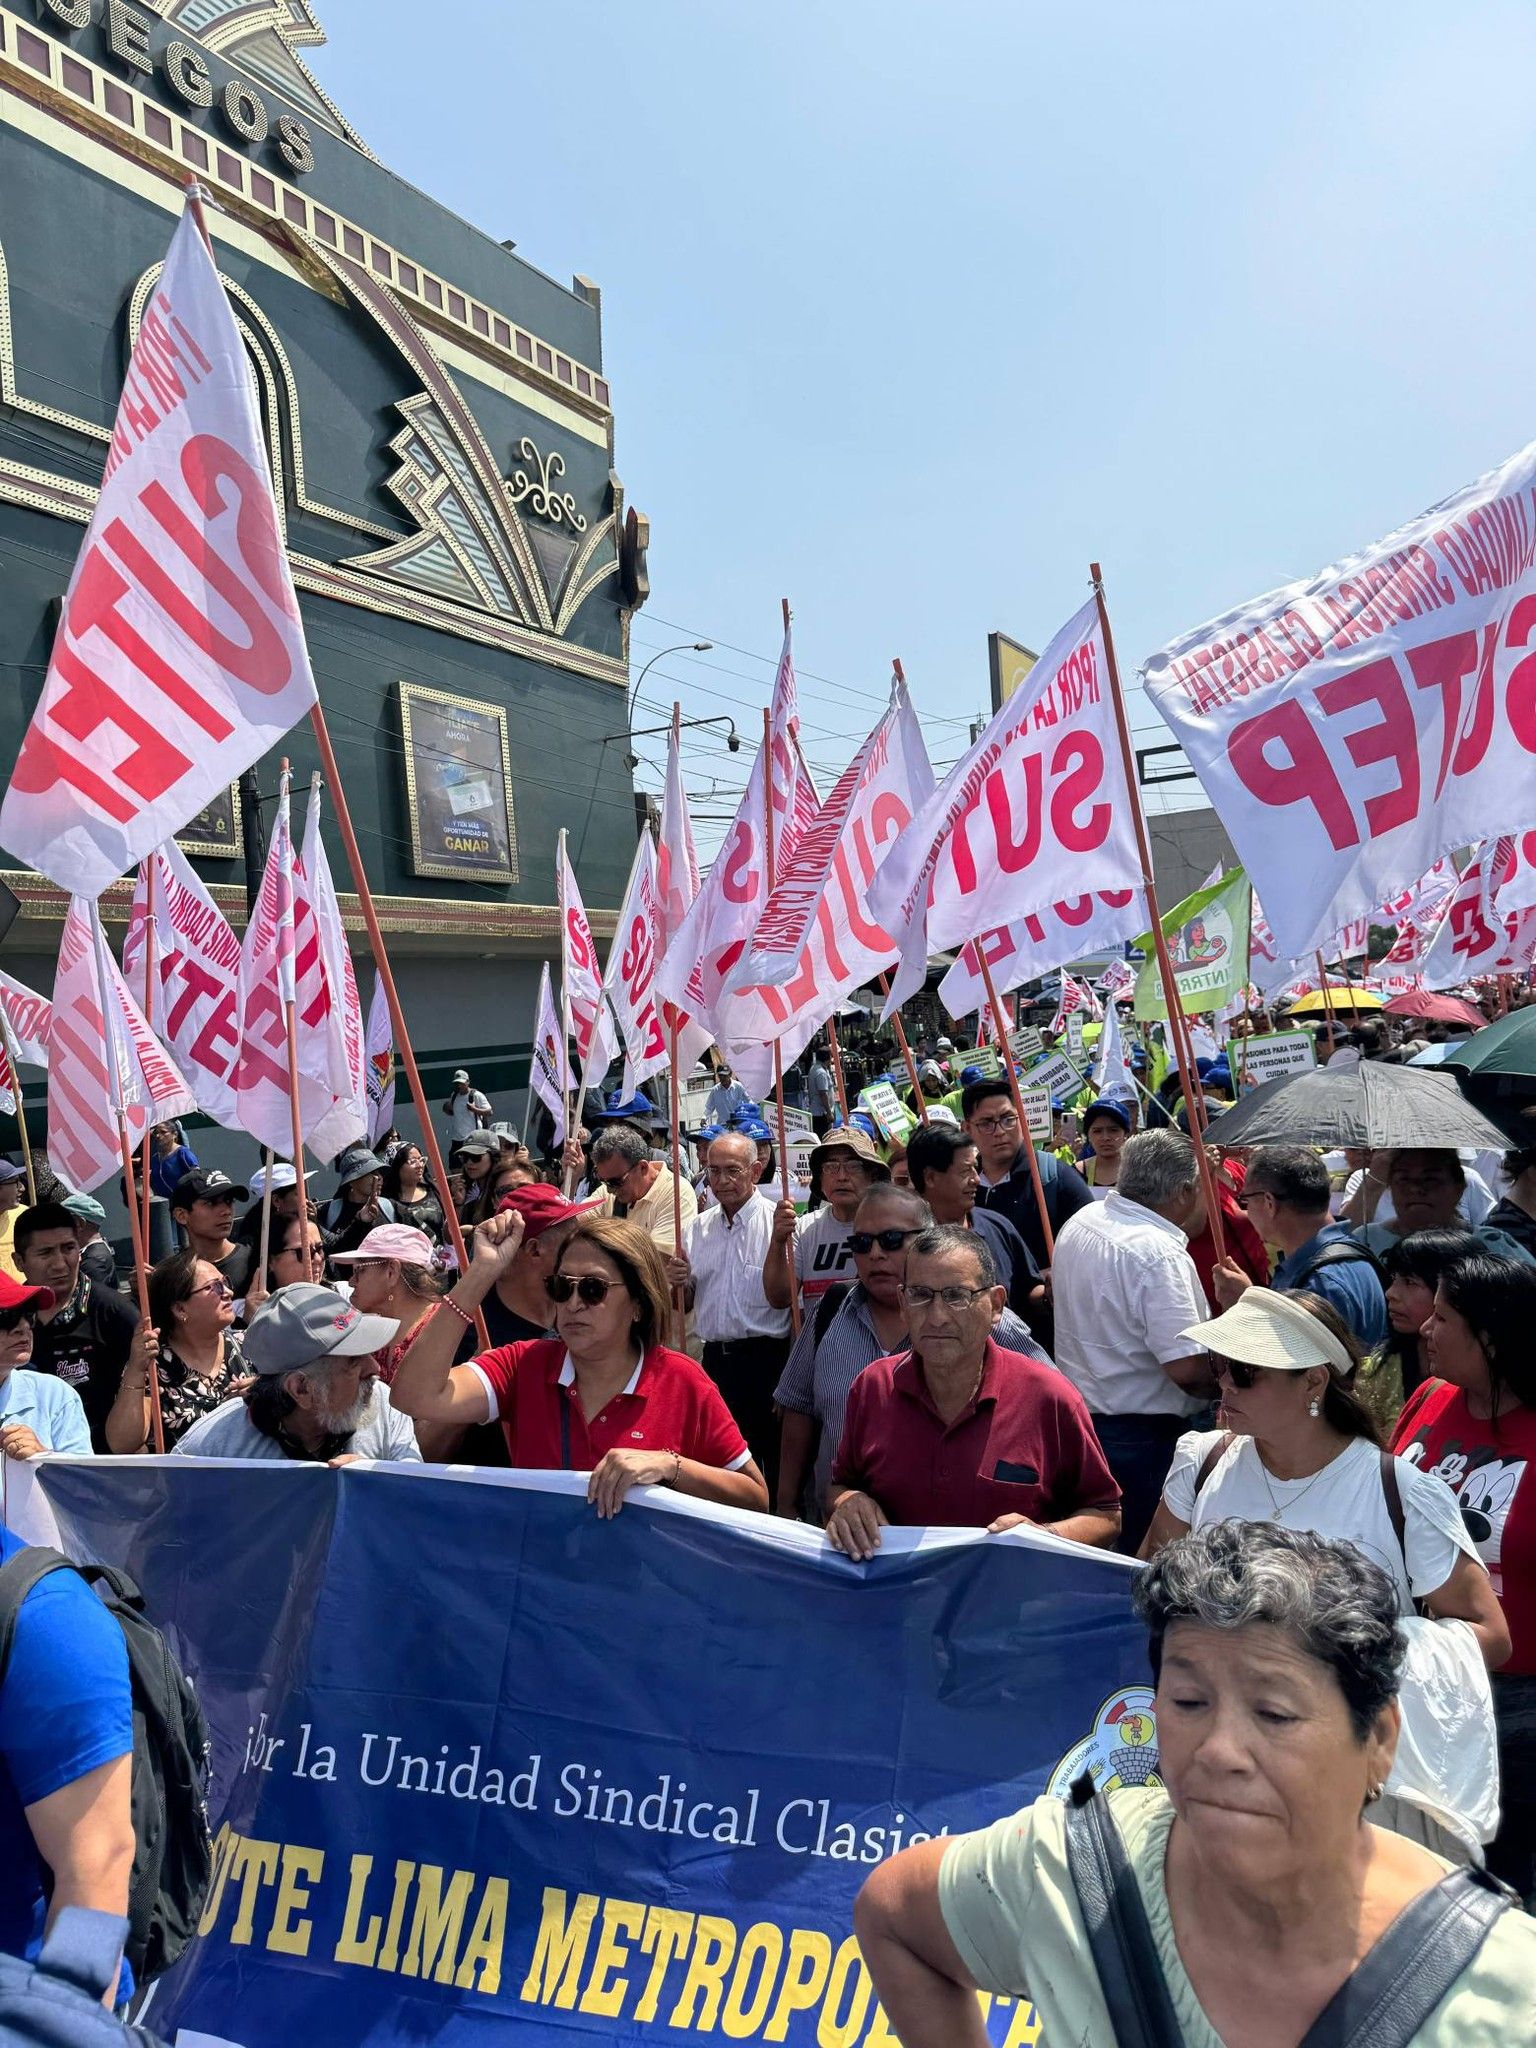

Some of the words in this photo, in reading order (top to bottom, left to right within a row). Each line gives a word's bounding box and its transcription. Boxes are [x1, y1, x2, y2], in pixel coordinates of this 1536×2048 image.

[445, 837, 490, 854] GANAR
[1237, 1047, 1272, 1061] PNSIONES
[1272, 1045, 1289, 1054] PARA
[1289, 1042, 1310, 1051] TODAS
[1246, 1062, 1258, 1070] LAS
[1259, 1057, 1291, 1068] PERSONAS
[1292, 1054, 1306, 1063] QUE
[1038, 1060, 1069, 1084] CUIDADOS
[1051, 1072, 1071, 1090] ABAJO
[1265, 1069, 1289, 1079] CUIDAN
[813, 1242, 853, 1272] UF
[292, 1723, 338, 1782] la
[359, 1732, 542, 1812] Unidad
[553, 1761, 760, 1848] Sindical
[775, 1798, 950, 1864] Clasi
[333, 1852, 510, 1996] LIMA
